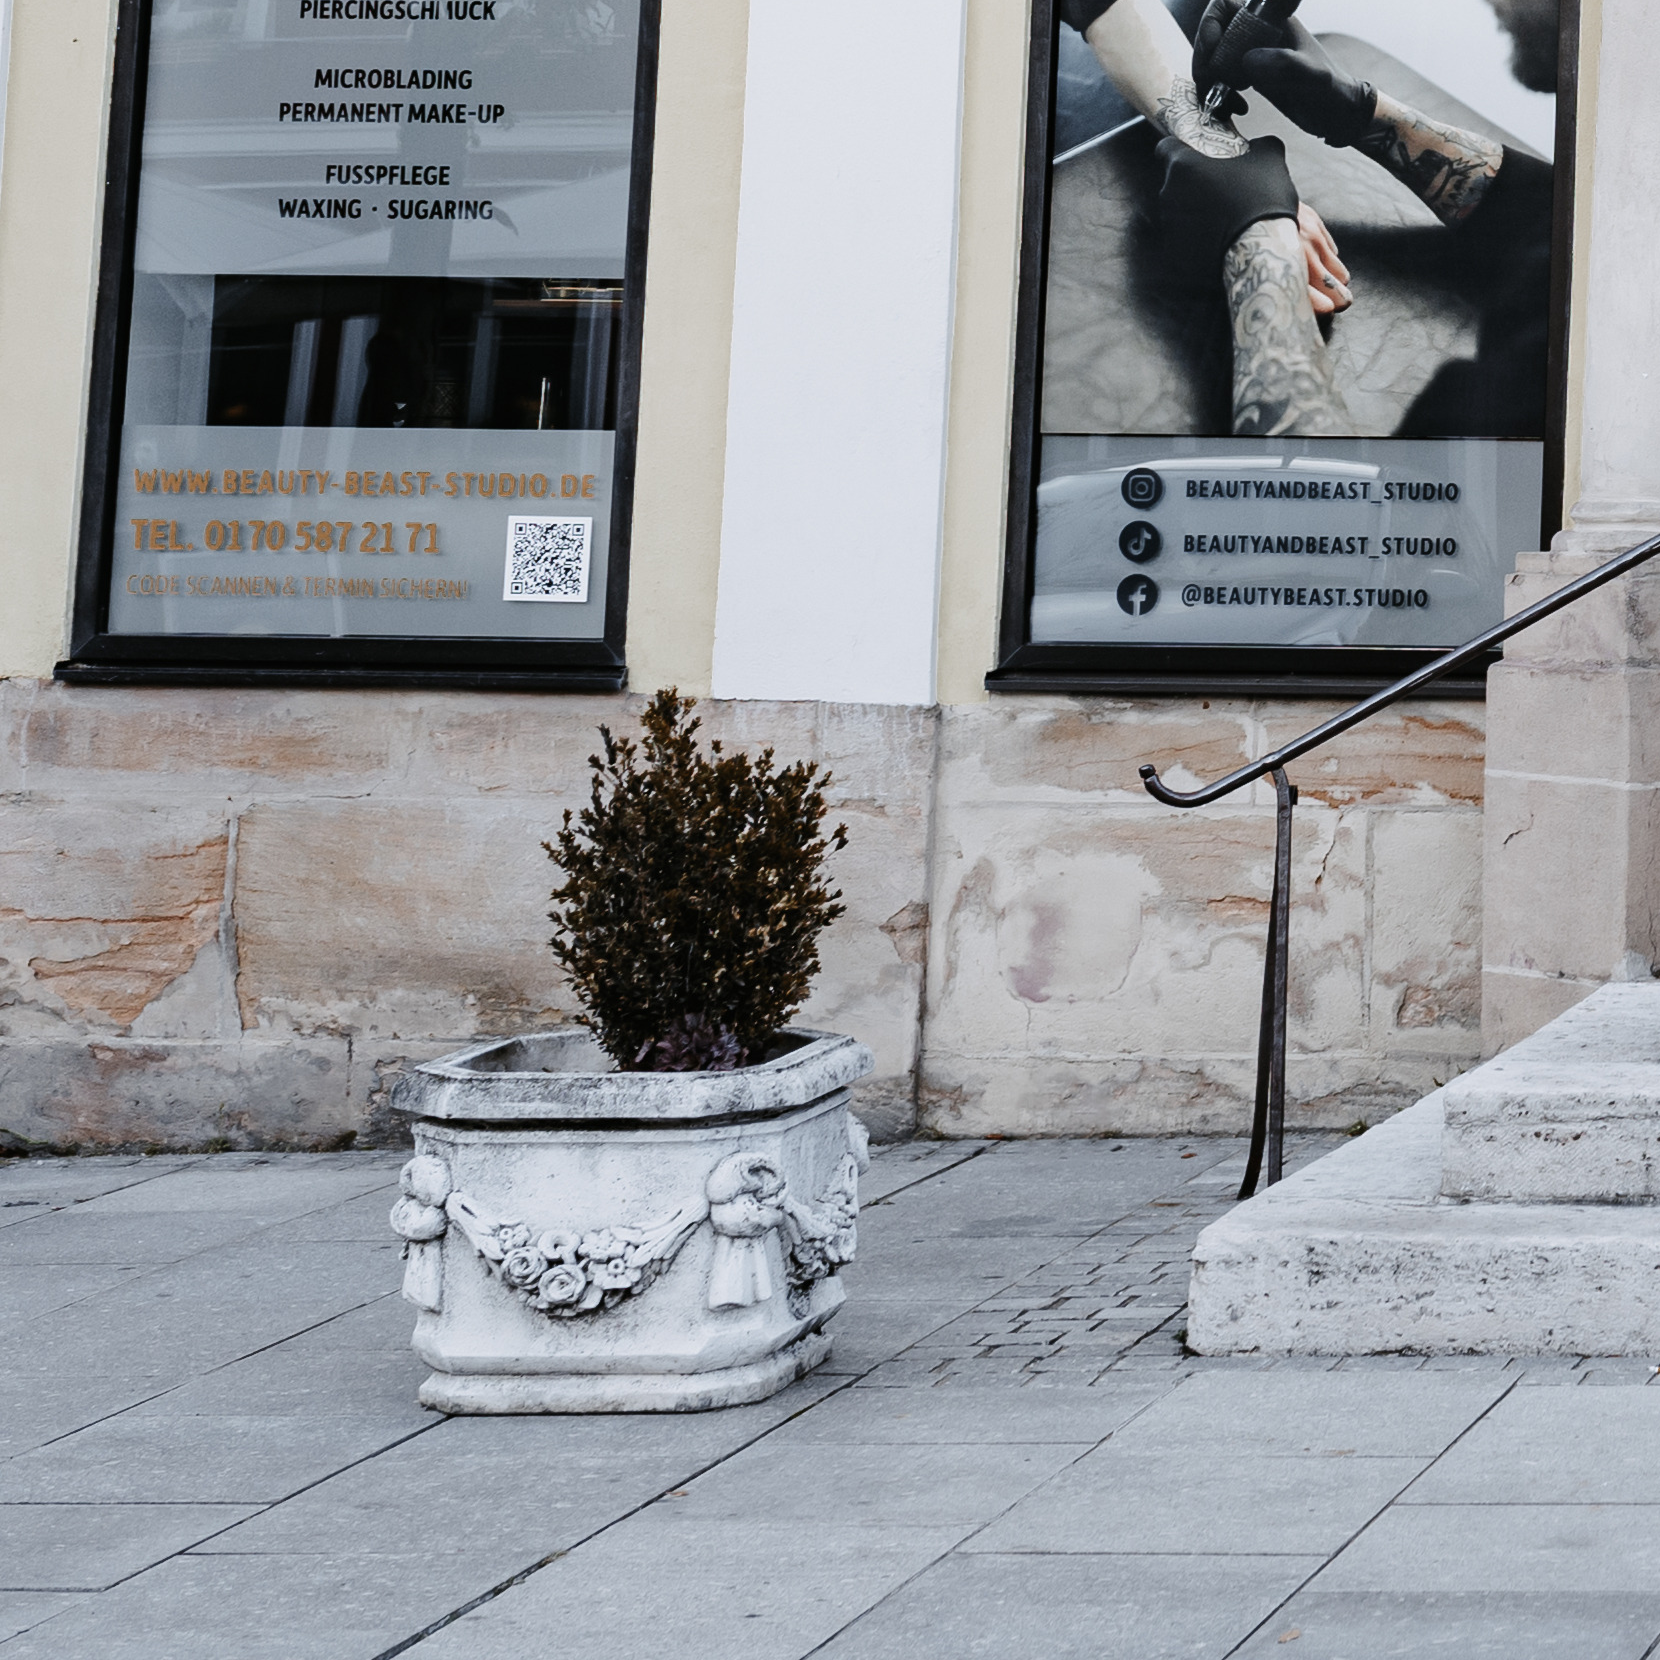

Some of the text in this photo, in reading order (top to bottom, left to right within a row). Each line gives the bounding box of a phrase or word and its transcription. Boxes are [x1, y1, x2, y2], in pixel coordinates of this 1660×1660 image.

[314, 68, 473, 90] MICROBLADING
[279, 102, 505, 125] PERMANENT MAKE-UP
[325, 165, 451, 187] FUSSPFLEGE
[278, 198, 494, 221] WAXING SUGARING
[133, 468, 596, 499] WWW.BEAUTY-BEAST-STUDIO.DE
[1186, 480, 1459, 504] BEAUTYANDBEAST_STUDIO
[131, 518, 440, 555] TEL. 0170 587 21 71
[1183, 534, 1458, 560] BEAUTYANDBEAST_STUDIO
[126, 574, 468, 600] CODE SCANNEN & TERMIN SICHERN!
[1181, 583, 1429, 608] @BEAUTYBEAST.STUDIO
